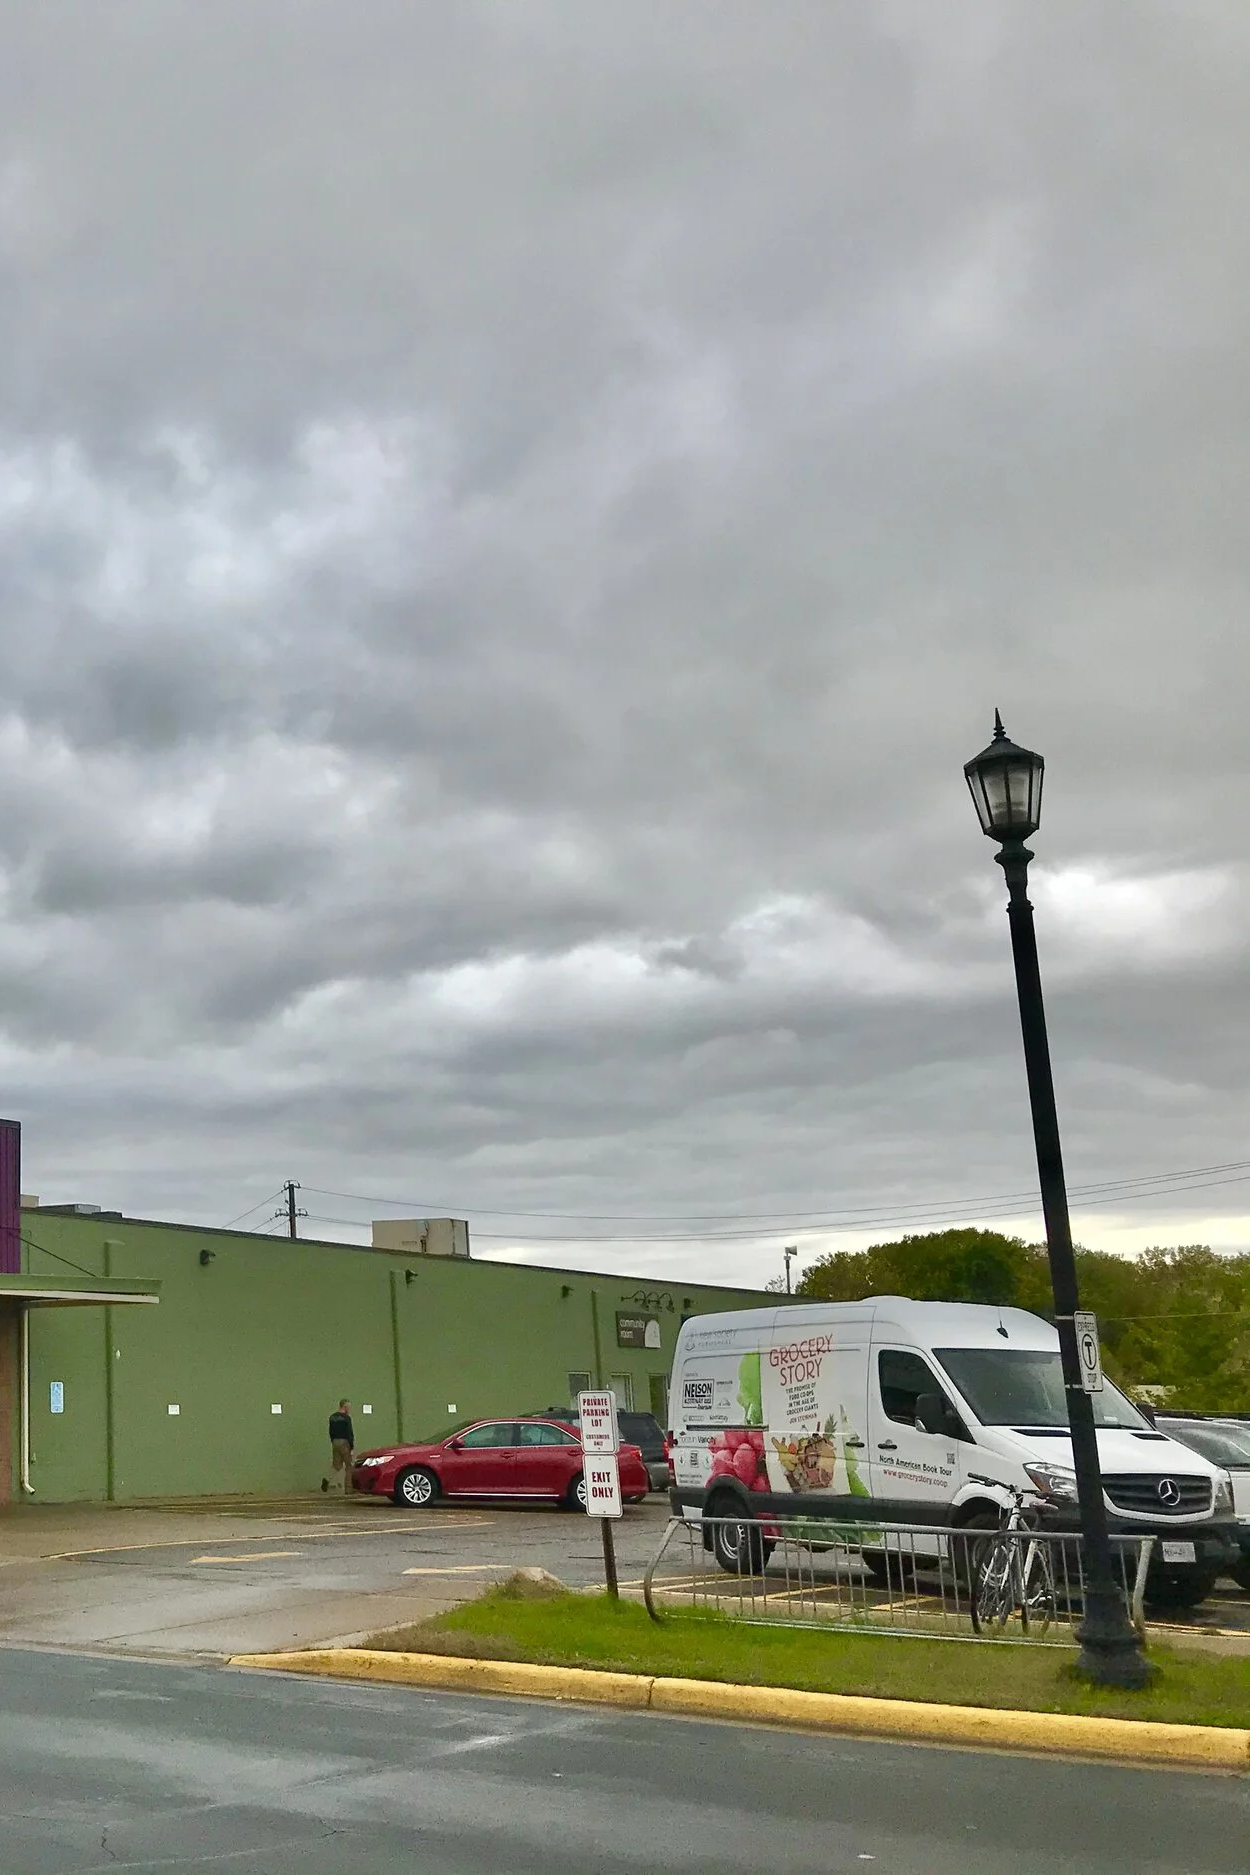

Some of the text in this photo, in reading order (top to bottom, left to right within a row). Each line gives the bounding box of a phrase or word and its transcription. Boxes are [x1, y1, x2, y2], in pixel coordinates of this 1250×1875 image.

[769, 1333, 833, 1367] GROCERY
[780, 1357, 822, 1387] STORY
[685, 1383, 712, 1398] NELSON
[582, 1398, 608, 1406] PRIVATE
[582, 1408, 609, 1417] PARKING
[591, 1419, 602, 1427] LOT
[879, 1454, 952, 1476] North American Book Tour
[592, 1472, 611, 1483] EXIT
[592, 1487, 614, 1498] ONLY
